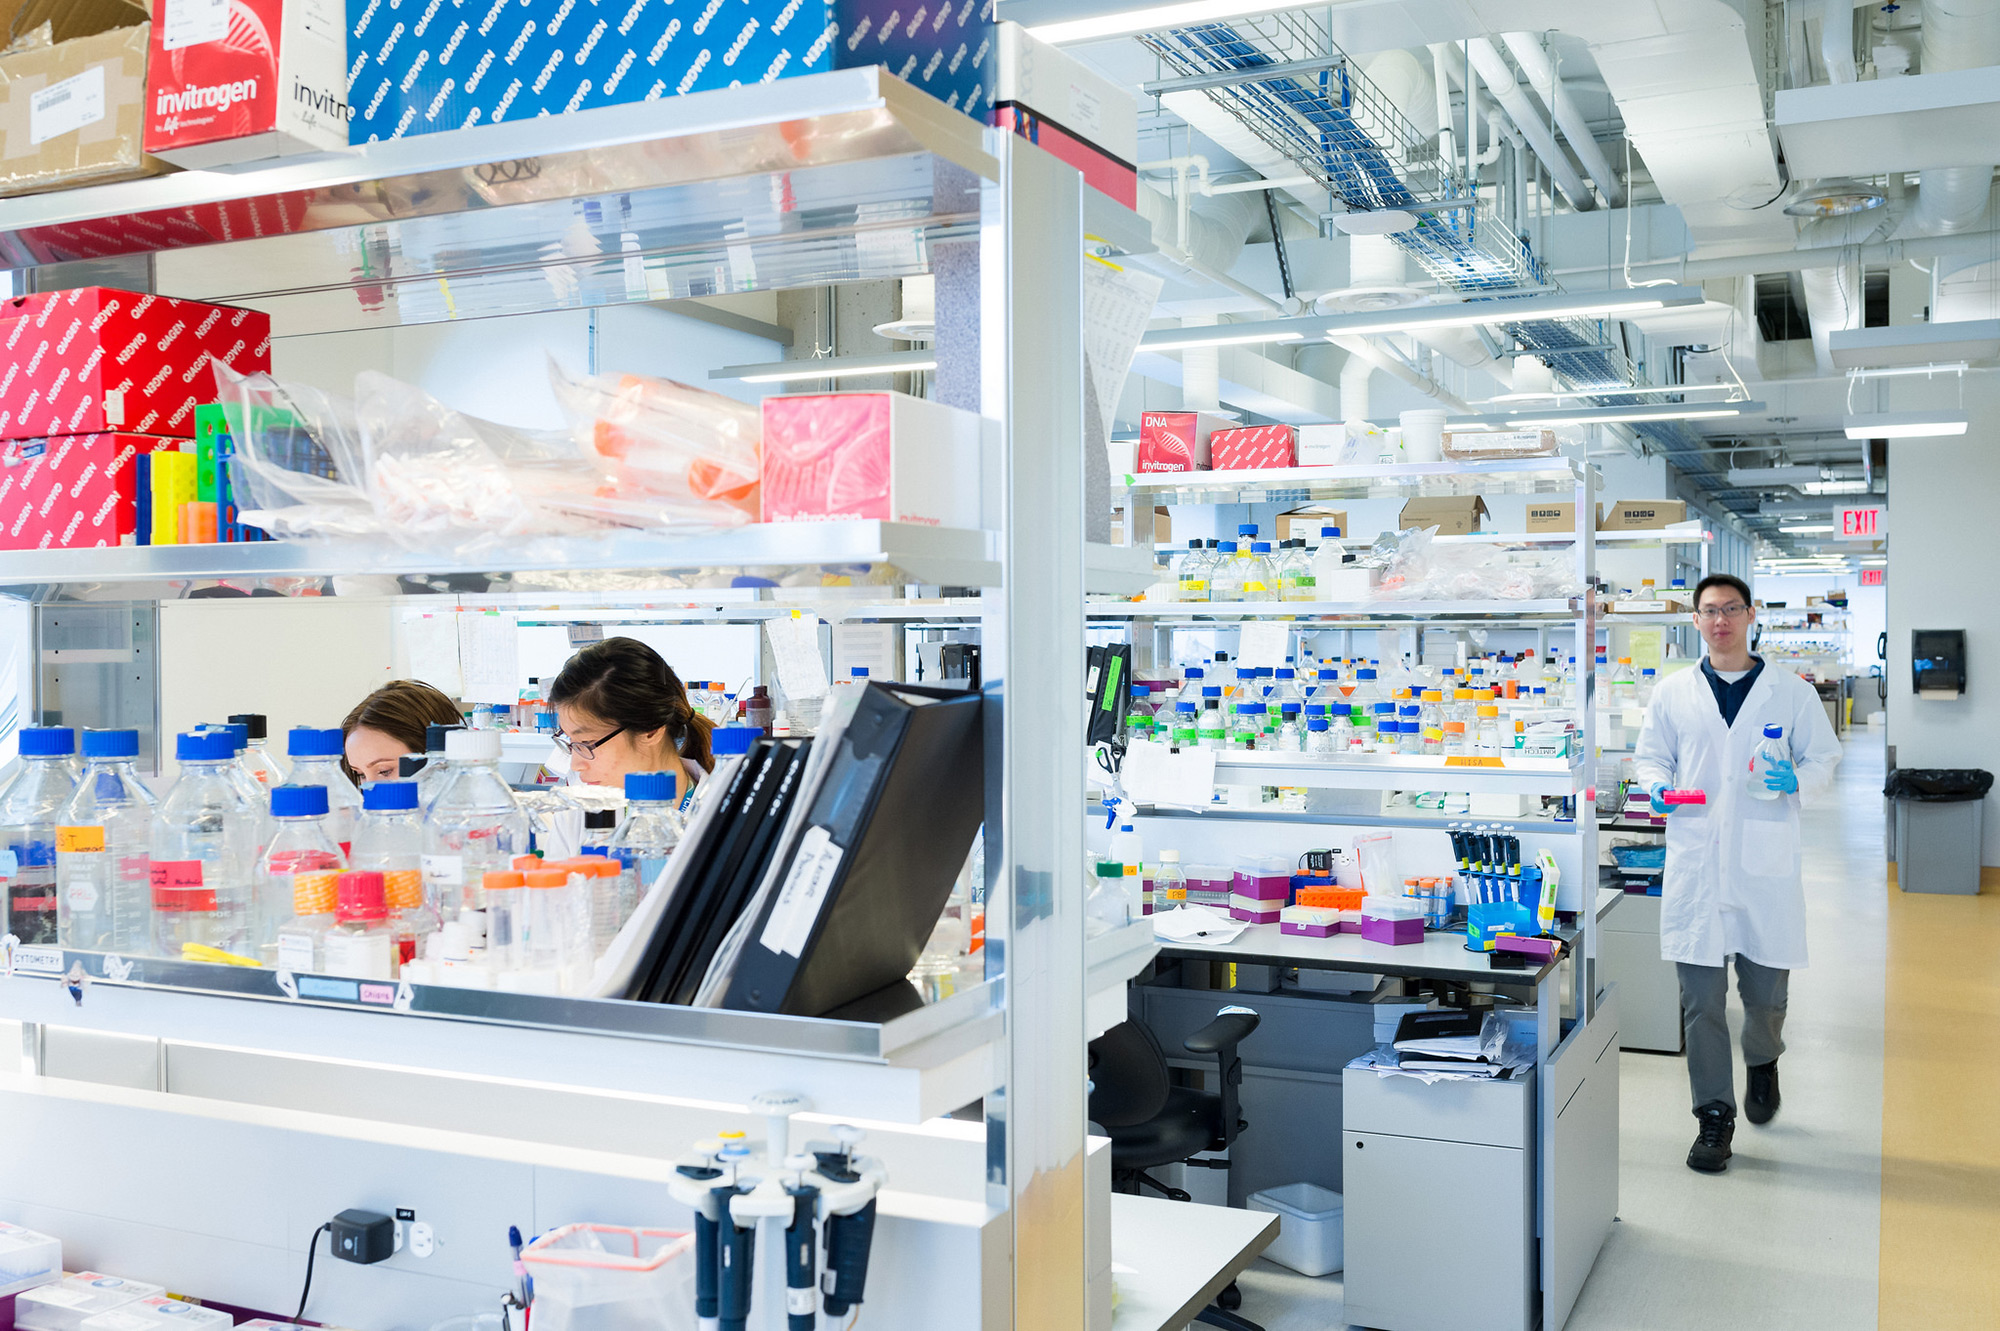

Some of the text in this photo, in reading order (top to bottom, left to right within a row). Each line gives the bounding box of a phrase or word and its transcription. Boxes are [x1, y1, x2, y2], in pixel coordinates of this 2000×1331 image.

[375, 21, 405, 66] QIAGEN
[438, 20, 470, 66] QIAGEN
[504, 19, 537, 66] QIAGEN
[574, 18, 608, 66] QIAGEN
[646, 18, 682, 67] QIAGEN
[722, 17, 760, 67] QIAGEN
[347, 50, 369, 93] IAGEN
[399, 49, 430, 94] QIAGEN
[464, 48, 496, 94] QIAGEN
[531, 48, 564, 96] QIAGEN
[603, 48, 638, 96] QIAGEN
[676, 48, 712, 98] QIAGEN
[364, 77, 393, 121] QIAGEN
[424, 77, 456, 123] QIAGEN
[490, 77, 523, 124] QIAGEN
[5, 313, 30, 351] QIAGEN
[88, 298, 120, 334] QIAGEN
[194, 308, 222, 339] QIAGEN
[56, 317, 82, 356] QIAGEN
[115, 332, 148, 366] QIAGEN
[157, 319, 187, 352] QIAGEN
[25, 340, 50, 378] QIAGEN
[78, 344, 107, 383] QIAGEN
[46, 367, 71, 405] QIAGEN
[142, 364, 173, 398] QIAGEN
[17, 388, 41, 426] QIAGEN
[67, 394, 93, 432] QIAGEN
[167, 395, 198, 429] QIAGEN
[1145, 416, 1168, 428] DNA
[70, 461, 97, 498] QIAGEN
[104, 444, 136, 480] QIAGEN
[11, 501, 34, 537] QIAGEN
[39, 482, 63, 518] QIAGEN
[92, 489, 122, 527] QIAGEN
[60, 510, 85, 546] QIAGEN
[1843, 509, 1879, 535] EXIT
[1862, 569, 1883, 586] EXIT
[14, 953, 61, 966] CYTOMETRY
